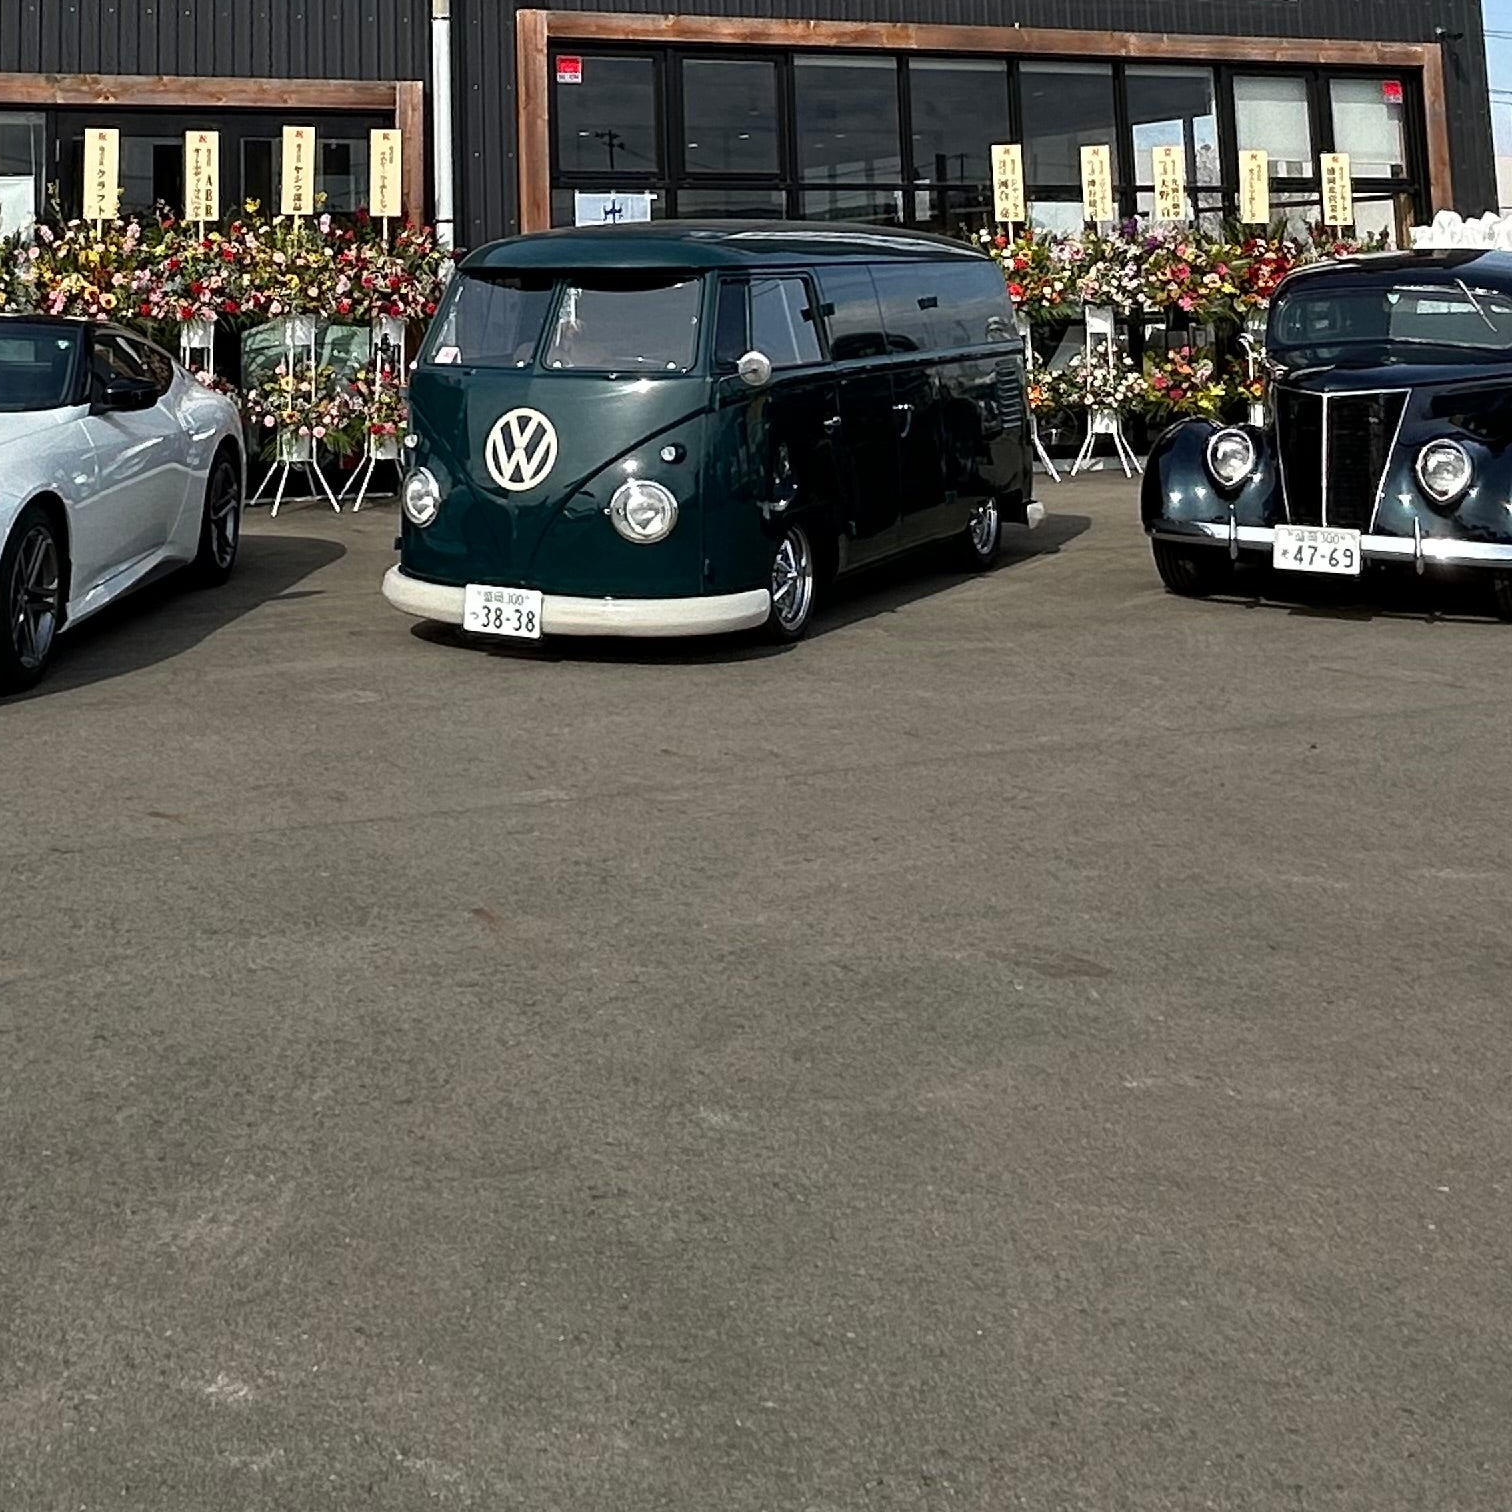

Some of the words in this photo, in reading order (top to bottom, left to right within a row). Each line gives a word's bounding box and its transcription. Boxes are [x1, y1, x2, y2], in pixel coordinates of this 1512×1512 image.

[485, 407, 558, 492] VW
[1293, 545, 1354, 569] 47-69
[481, 605, 536, 633] 38-38
